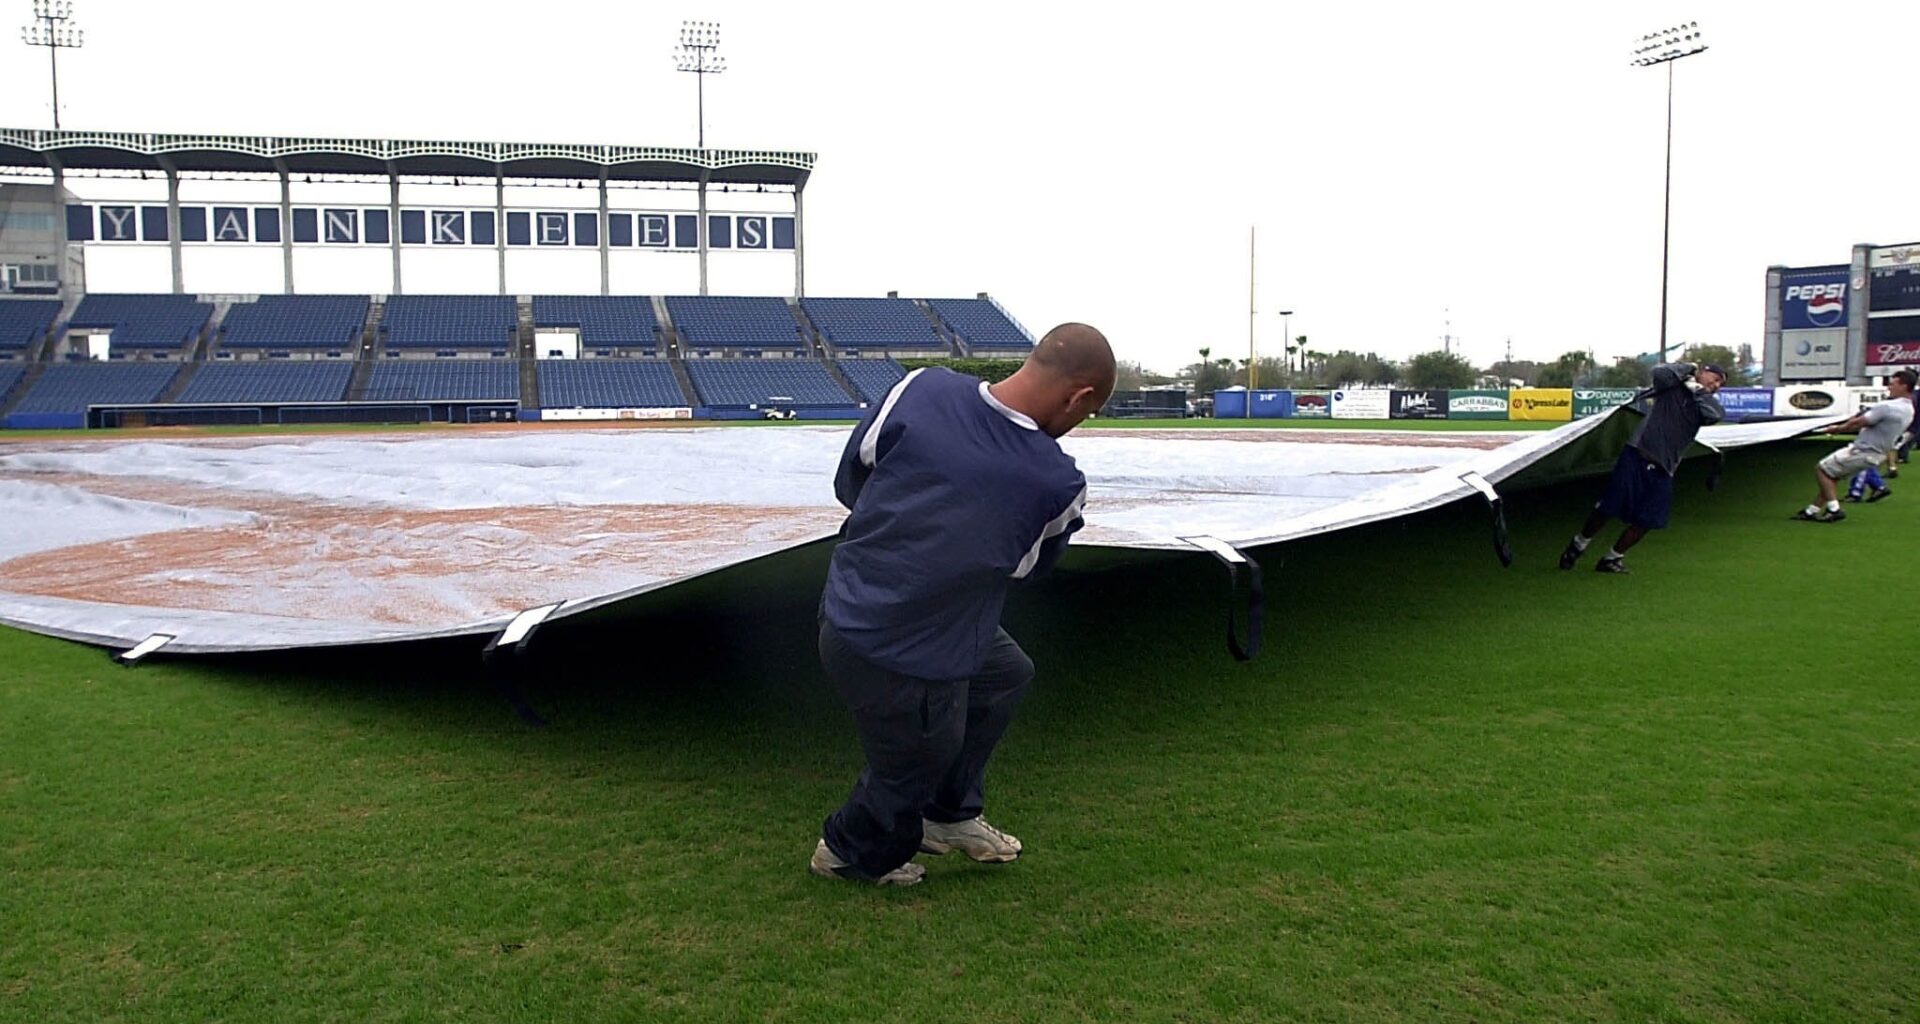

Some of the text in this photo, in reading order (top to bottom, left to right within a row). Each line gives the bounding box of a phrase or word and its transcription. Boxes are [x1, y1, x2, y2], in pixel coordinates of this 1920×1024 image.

[102, 208, 761, 247] YANKEES
[1785, 283, 1847, 301] PEPSI
[1596, 390, 1635, 399] DAEWOO
